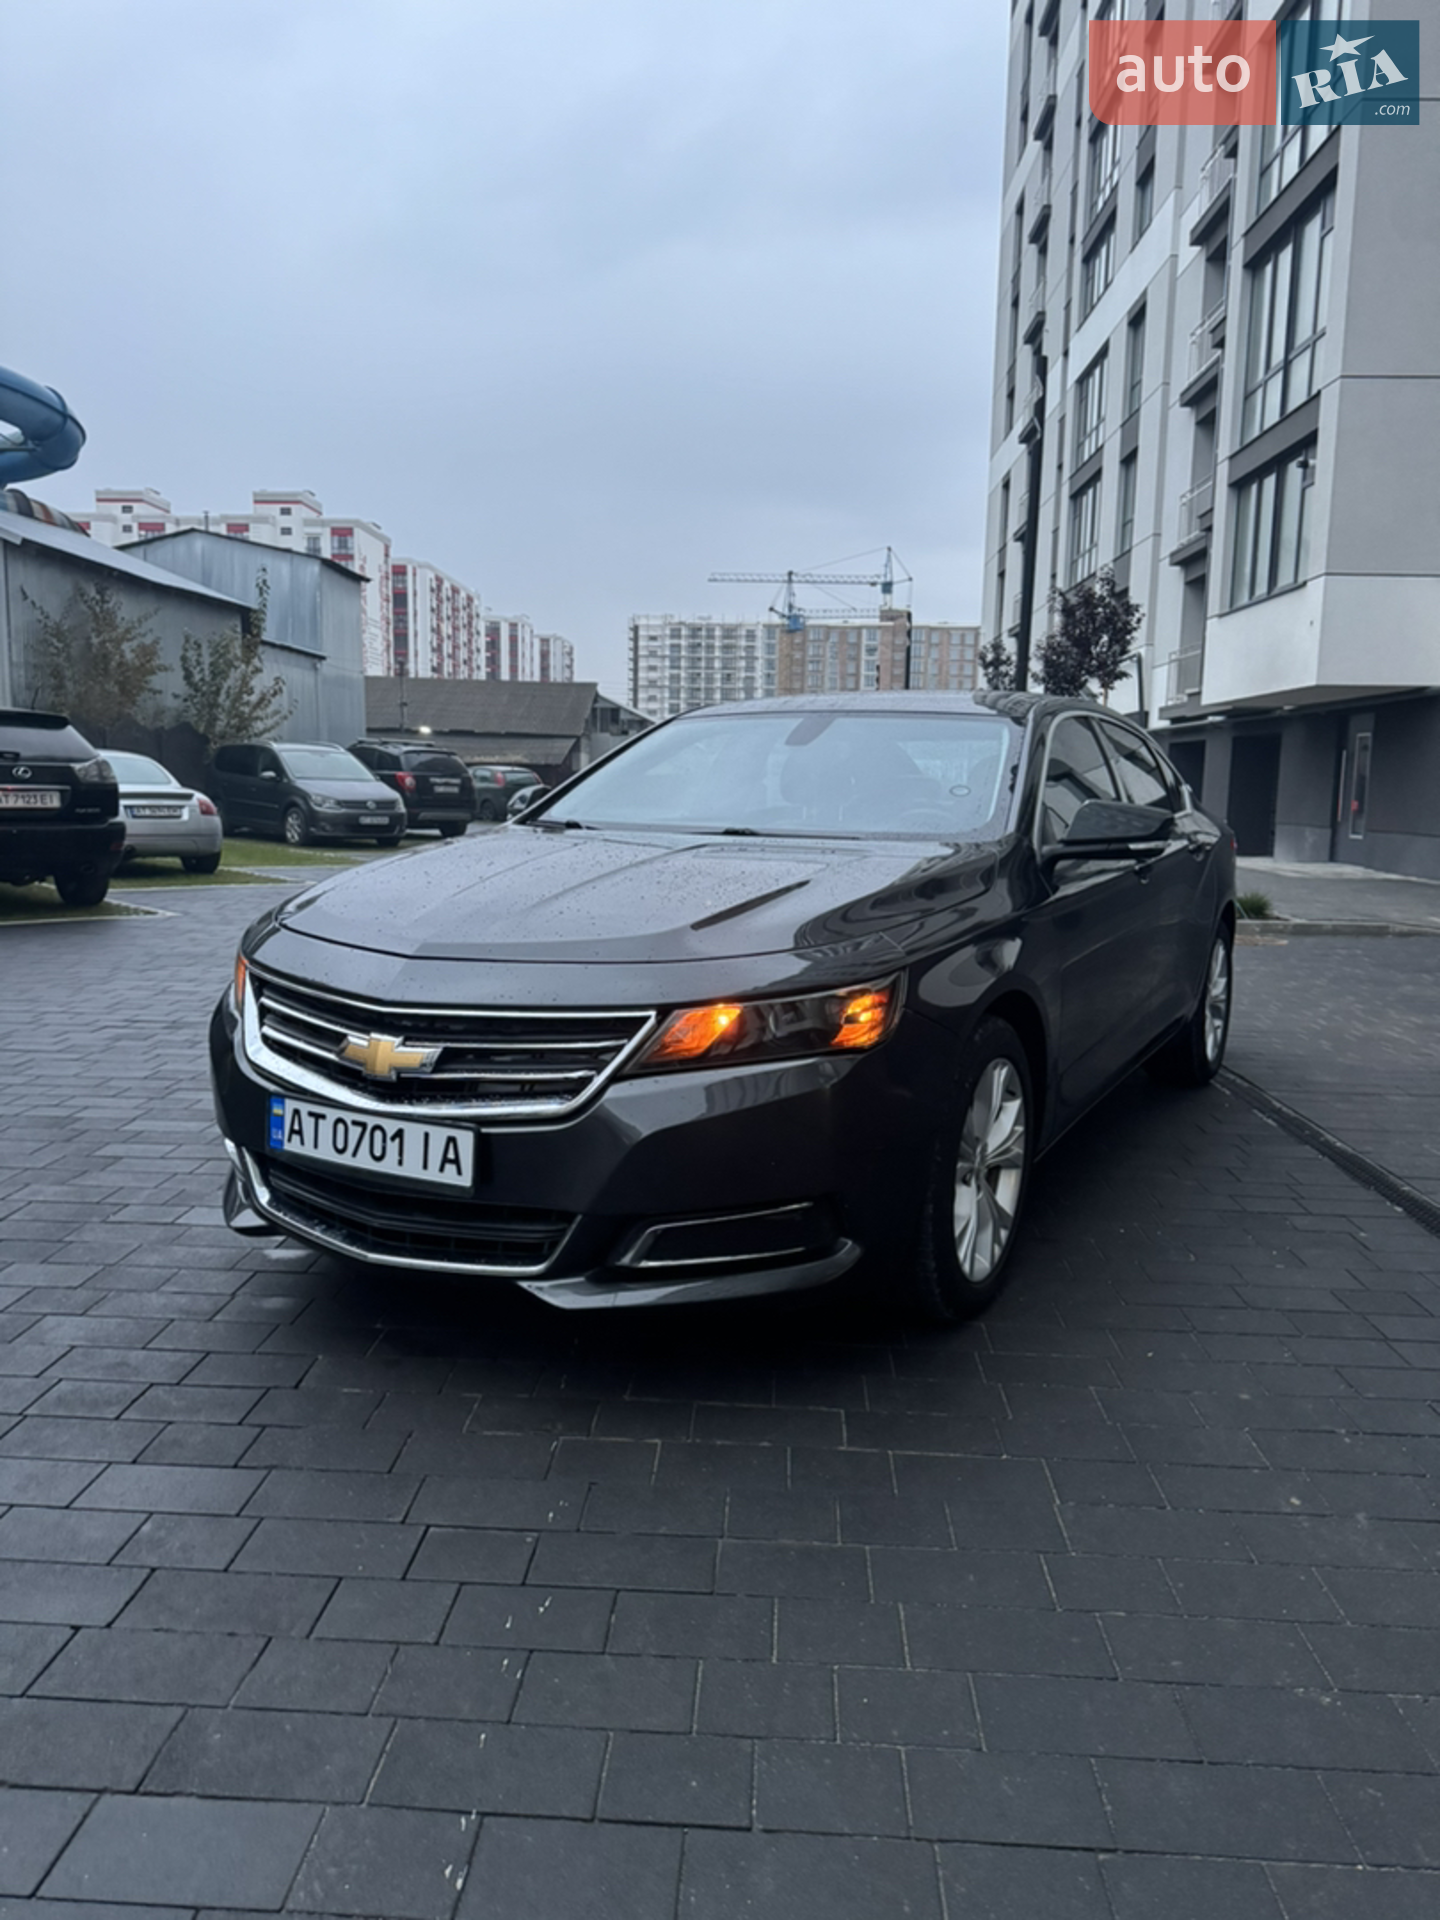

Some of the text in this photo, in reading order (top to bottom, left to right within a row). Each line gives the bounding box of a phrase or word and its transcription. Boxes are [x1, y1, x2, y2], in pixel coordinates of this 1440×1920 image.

[287, 1108, 462, 1177] AT 0701 IA
